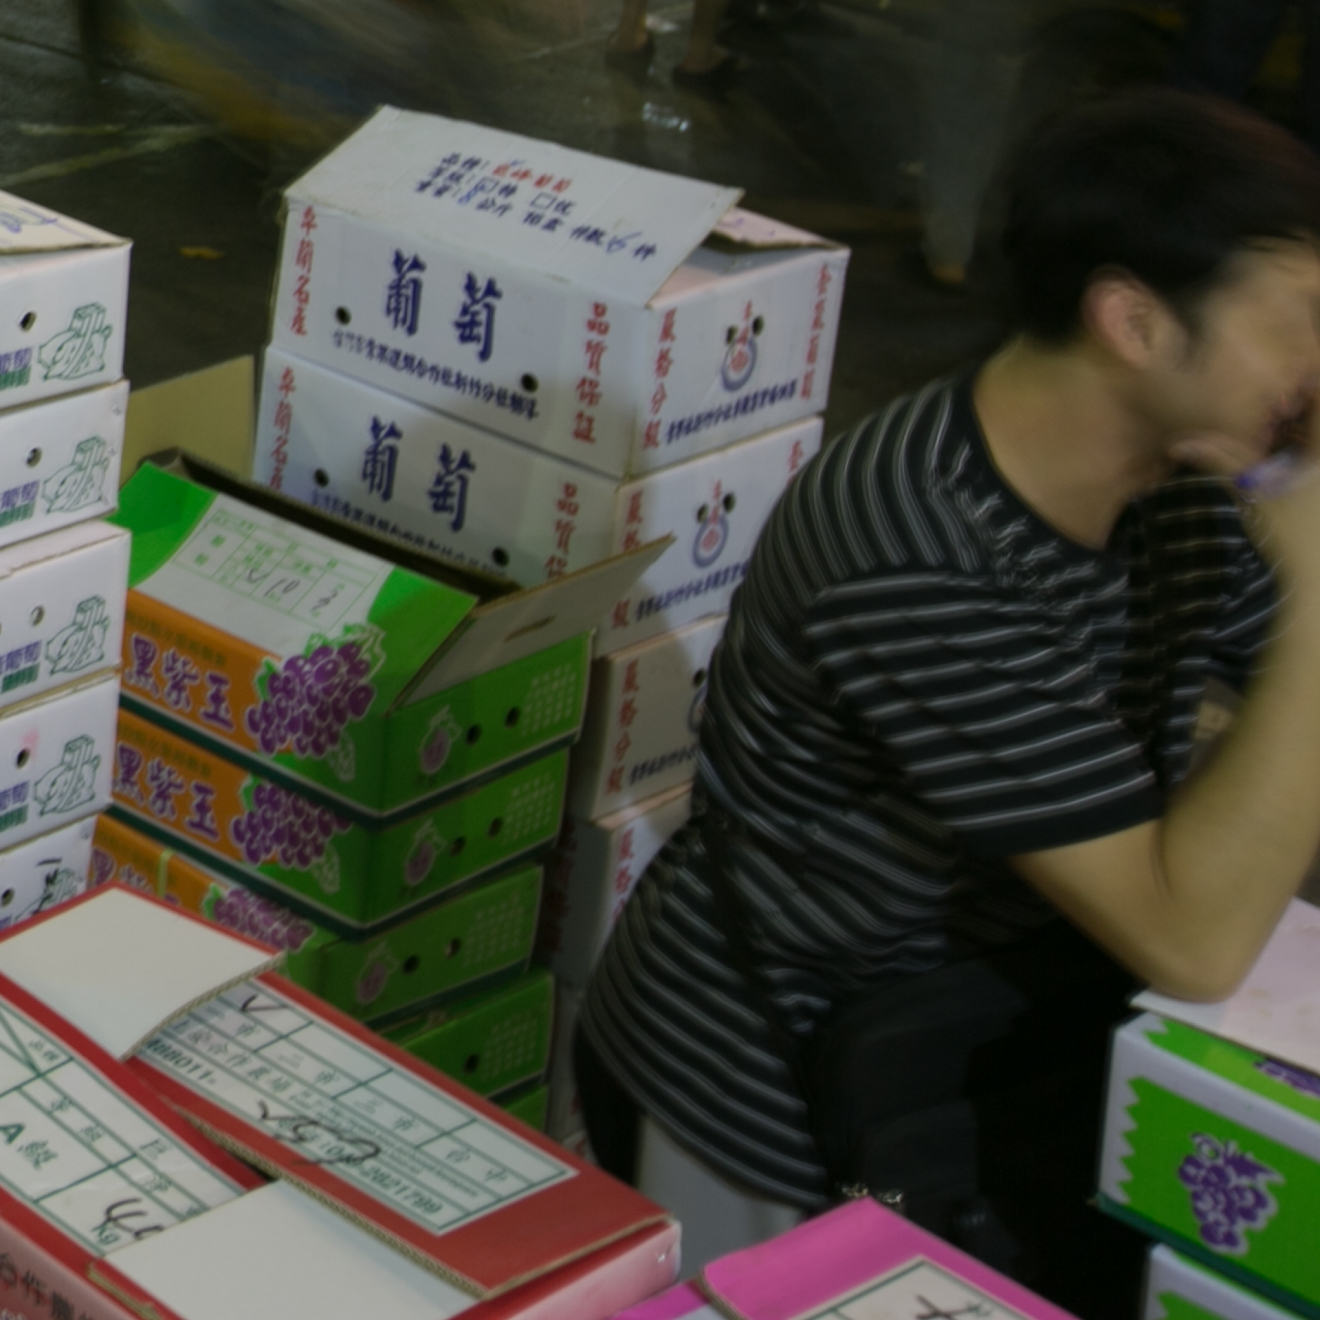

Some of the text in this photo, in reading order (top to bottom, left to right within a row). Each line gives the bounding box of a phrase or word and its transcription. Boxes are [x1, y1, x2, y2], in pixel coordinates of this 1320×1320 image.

[384, 249, 502, 363] 葡萄
[642, 307, 678, 451] 嚴格分級
[360, 415, 475, 534] 葡萄
[544, 481, 580, 579] 品質保
[124, 631, 236, 732] 黑紫玉
[115, 741, 221, 842] 黑紫玉
